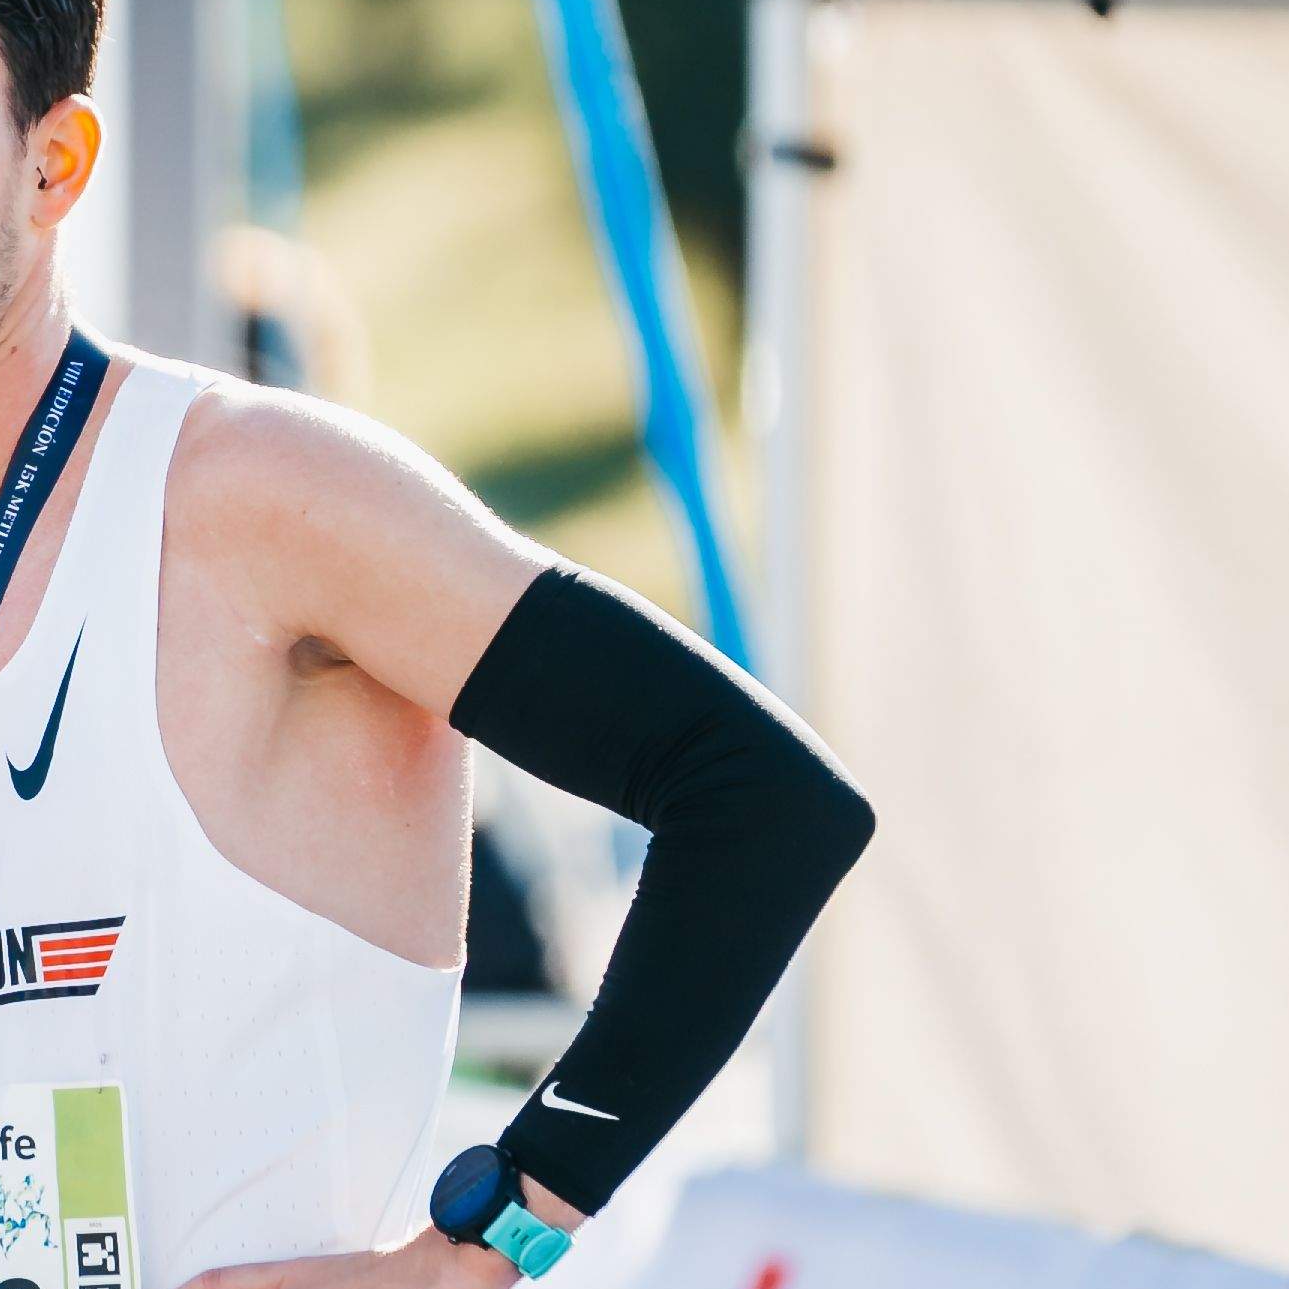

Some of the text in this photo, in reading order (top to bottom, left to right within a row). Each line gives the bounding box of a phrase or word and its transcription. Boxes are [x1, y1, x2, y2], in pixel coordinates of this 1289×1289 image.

[62, 361, 84, 386] VIII
[31, 386, 73, 457] EDICIÓN
[14, 463, 38, 493] 15K
